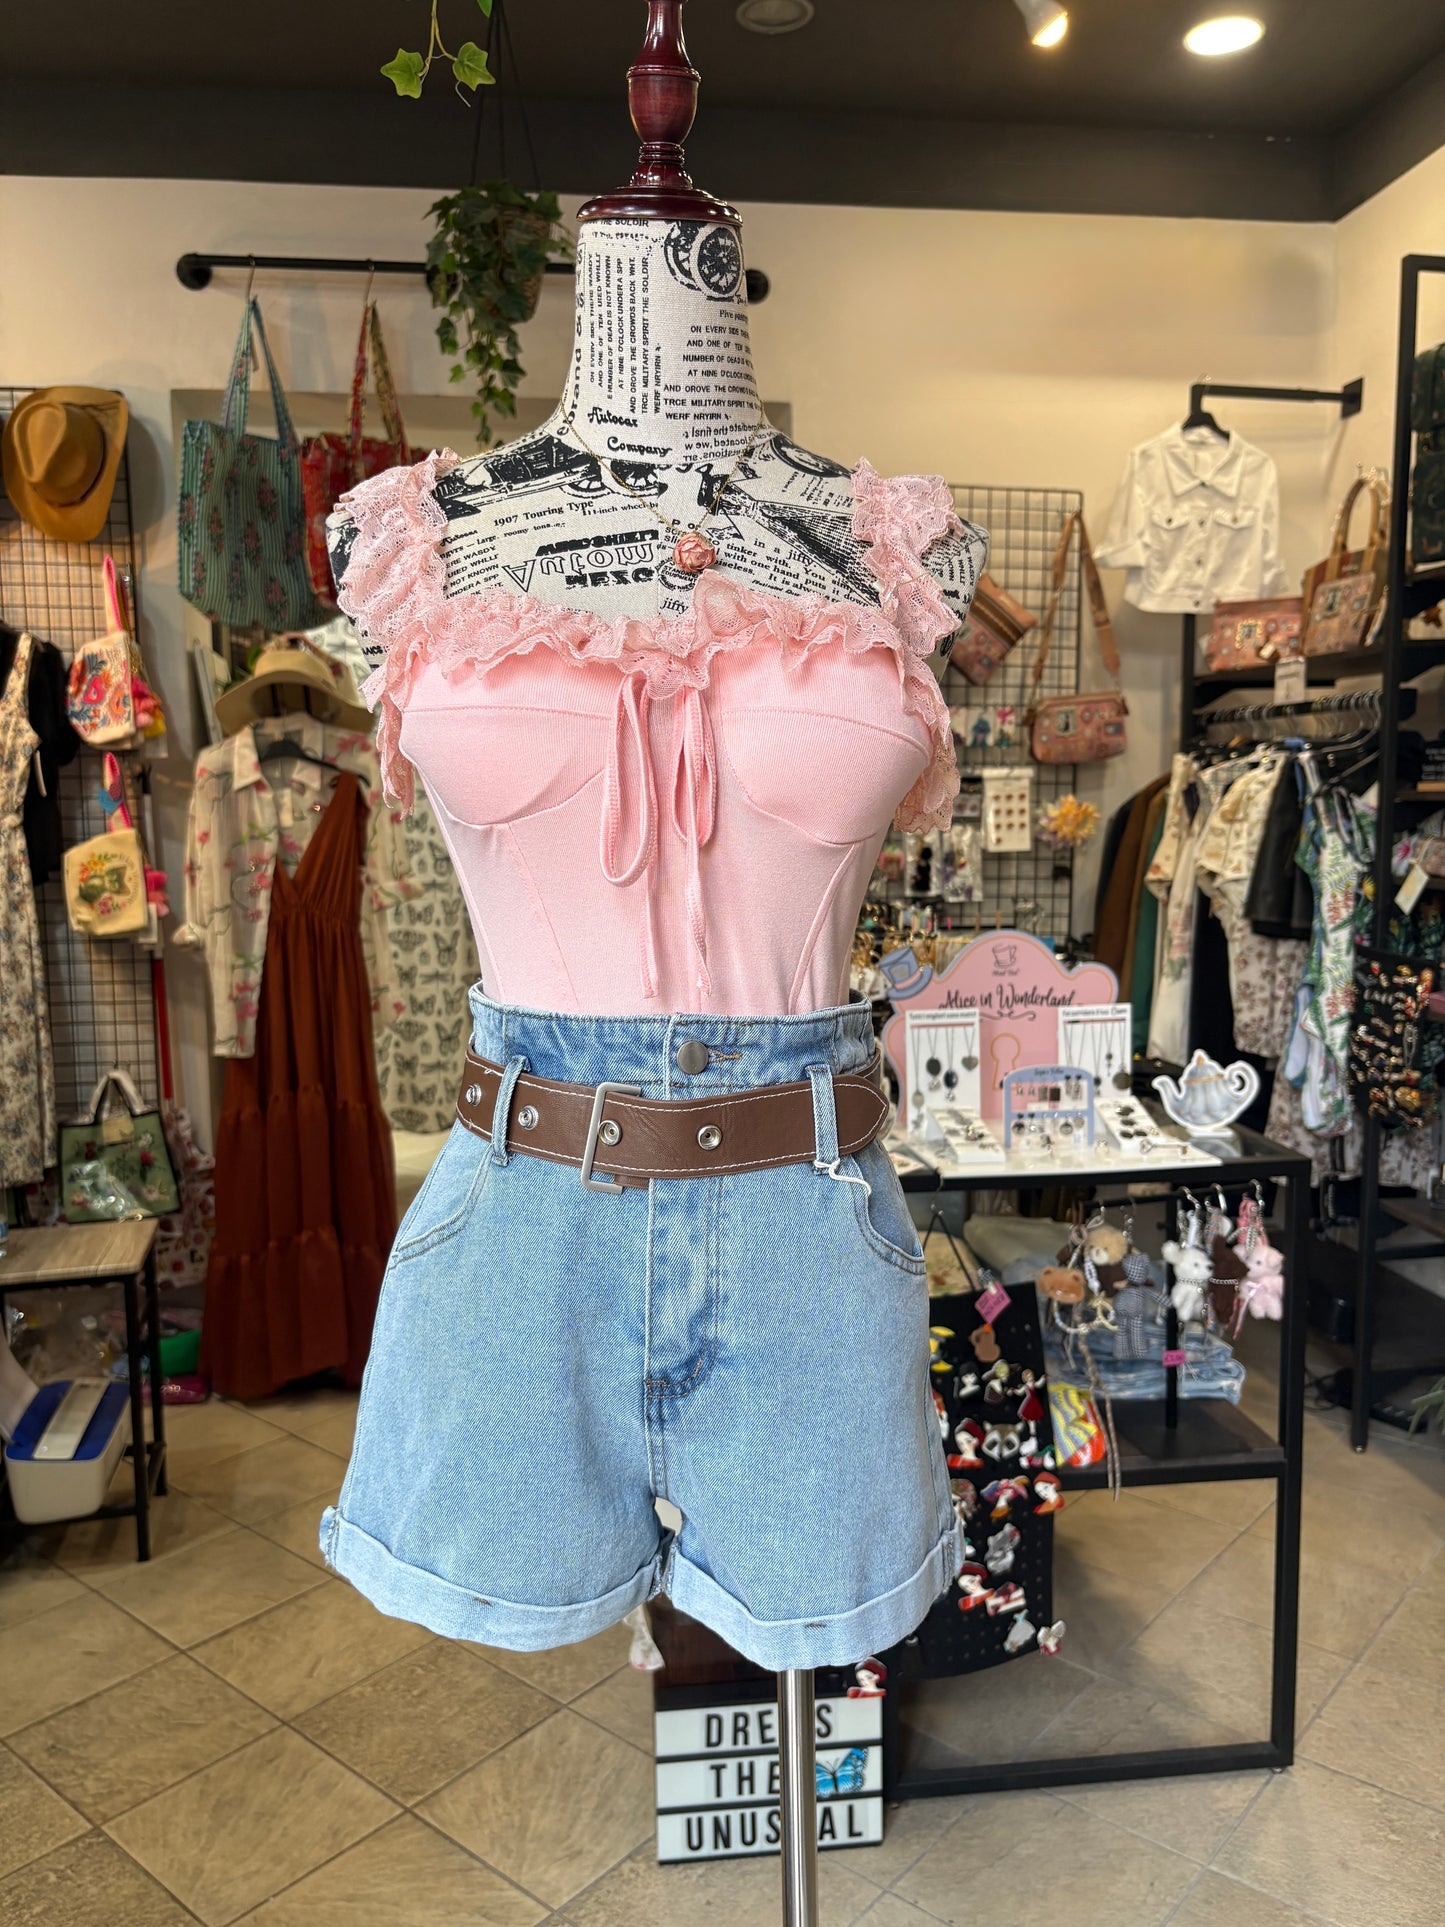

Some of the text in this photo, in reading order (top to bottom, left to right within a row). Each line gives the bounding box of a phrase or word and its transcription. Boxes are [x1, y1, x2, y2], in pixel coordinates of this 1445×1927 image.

[690, 325, 702, 333] ON
[705, 326, 727, 334] EVERY
[607, 345, 613, 357] OF
[686, 339, 703, 347] AND
[706, 340, 721, 348] ONE
[682, 354, 715, 362] NUMBER
[716, 355, 725, 363] OF
[687, 369, 698, 377] AT
[618, 378, 624, 390] AT
[663, 384, 681, 393] AND
[685, 385, 711, 393] OROVE
[714, 385, 726, 393] THE
[663, 398, 687, 407] TRCE
[691, 399, 726, 408] MILITARY
[587, 406, 638, 428] Autocar
[665, 412, 691, 420] WERF
[607, 436, 672, 457] Company
[493, 514, 519, 527] 1907
[523, 506, 564, 521] Touring
[566, 500, 594, 512] Type
[503, 528, 529, 538] roomy
[753, 537, 817, 568] in a jiffy.
[726, 542, 758, 558] tinker
[765, 554, 792, 570] with.
[802, 566, 826, 582] You
[450, 576, 465, 588] NOT
[467, 564, 499, 579] KNOWN
[483, 573, 499, 583] SPP
[723, 552, 748, 564] with
[750, 560, 771, 571] one
[773, 565, 800, 580] hand
[804, 577, 827, 591] puts
[831, 588, 840, 596] it
[768, 573, 777, 582] It
[781, 577, 790, 586] is
[659, 597, 689, 615] jiffy
[938, 982, 1076, 1009] Alice in Wonderland
[705, 1703, 833, 1748] DRES
[709, 1759, 780, 1798] THE
[686, 1803, 863, 1851] UNUSAL
